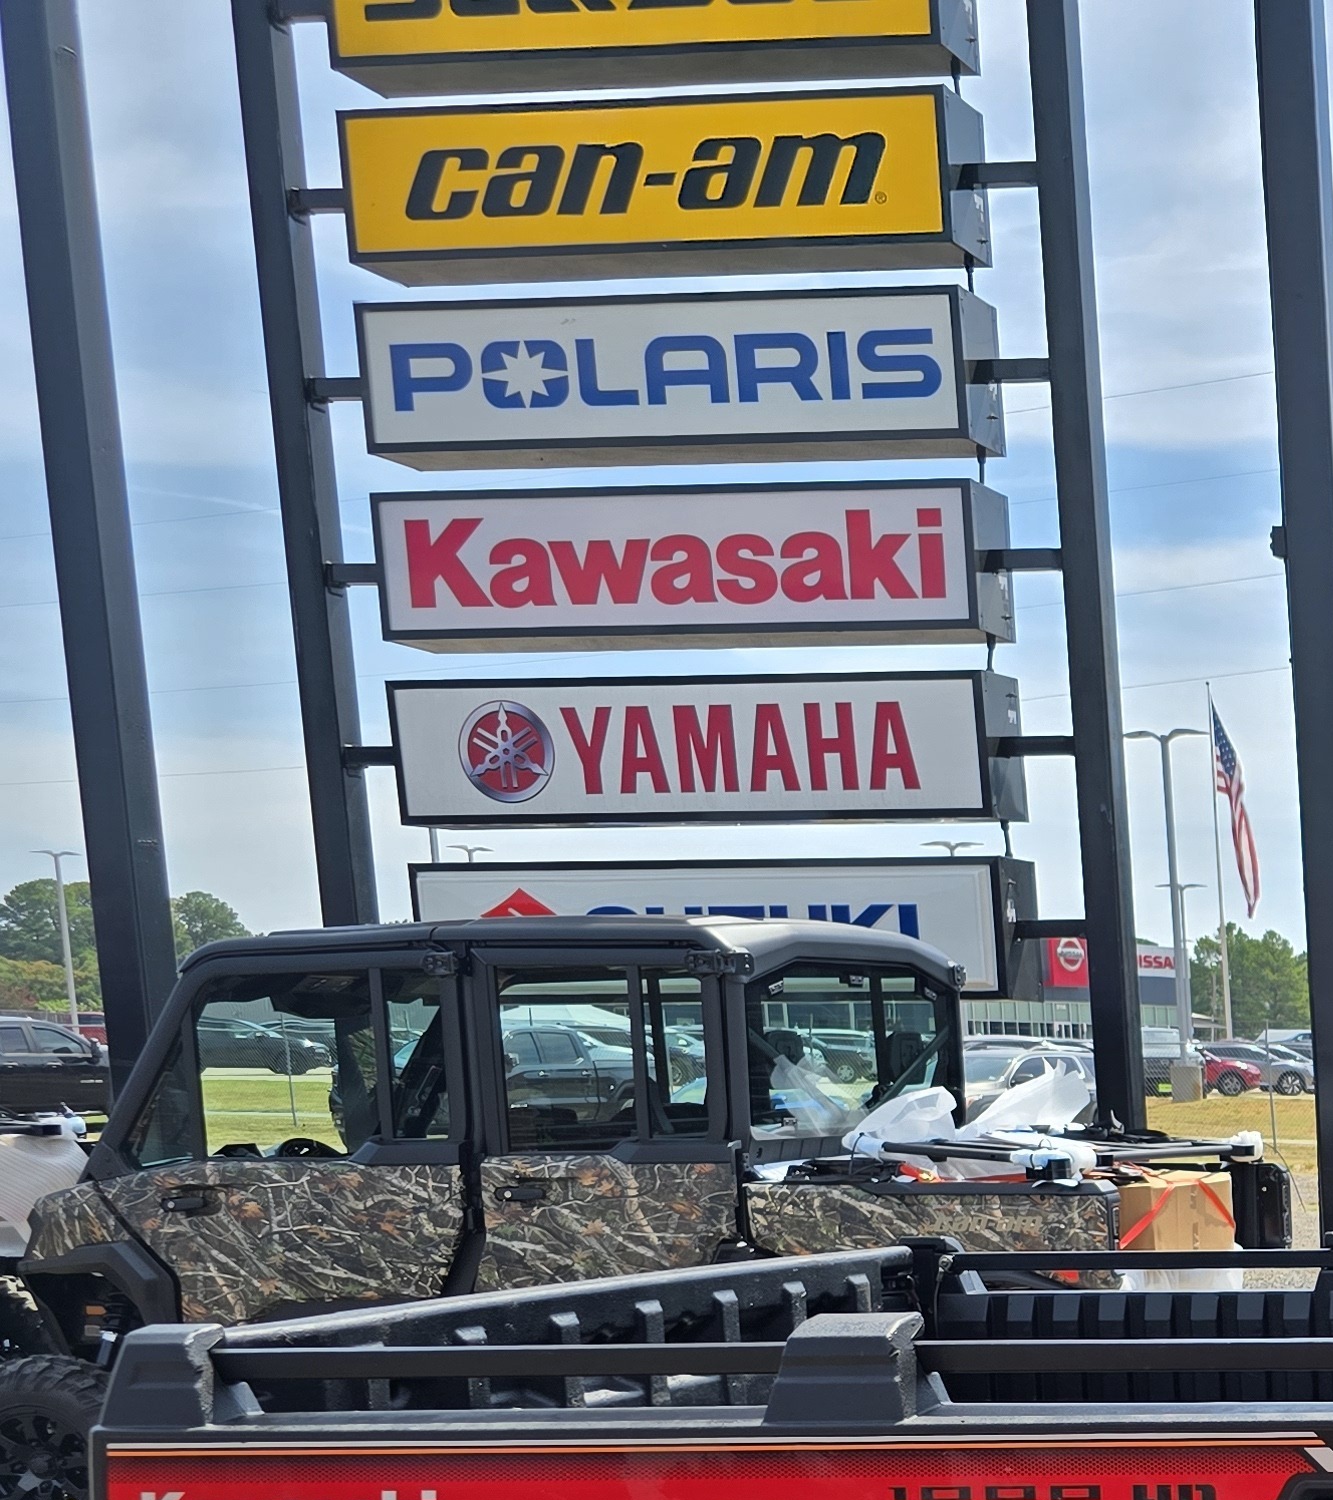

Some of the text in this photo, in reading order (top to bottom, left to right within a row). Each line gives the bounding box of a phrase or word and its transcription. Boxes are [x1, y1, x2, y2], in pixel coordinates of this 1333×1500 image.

[405, 132, 886, 221] can-am
[389, 328, 943, 413] POLARIS
[403, 508, 947, 608] Kawasaki
[559, 701, 921, 795] YAMAHA
[1138, 955, 1174, 969] ISSA
